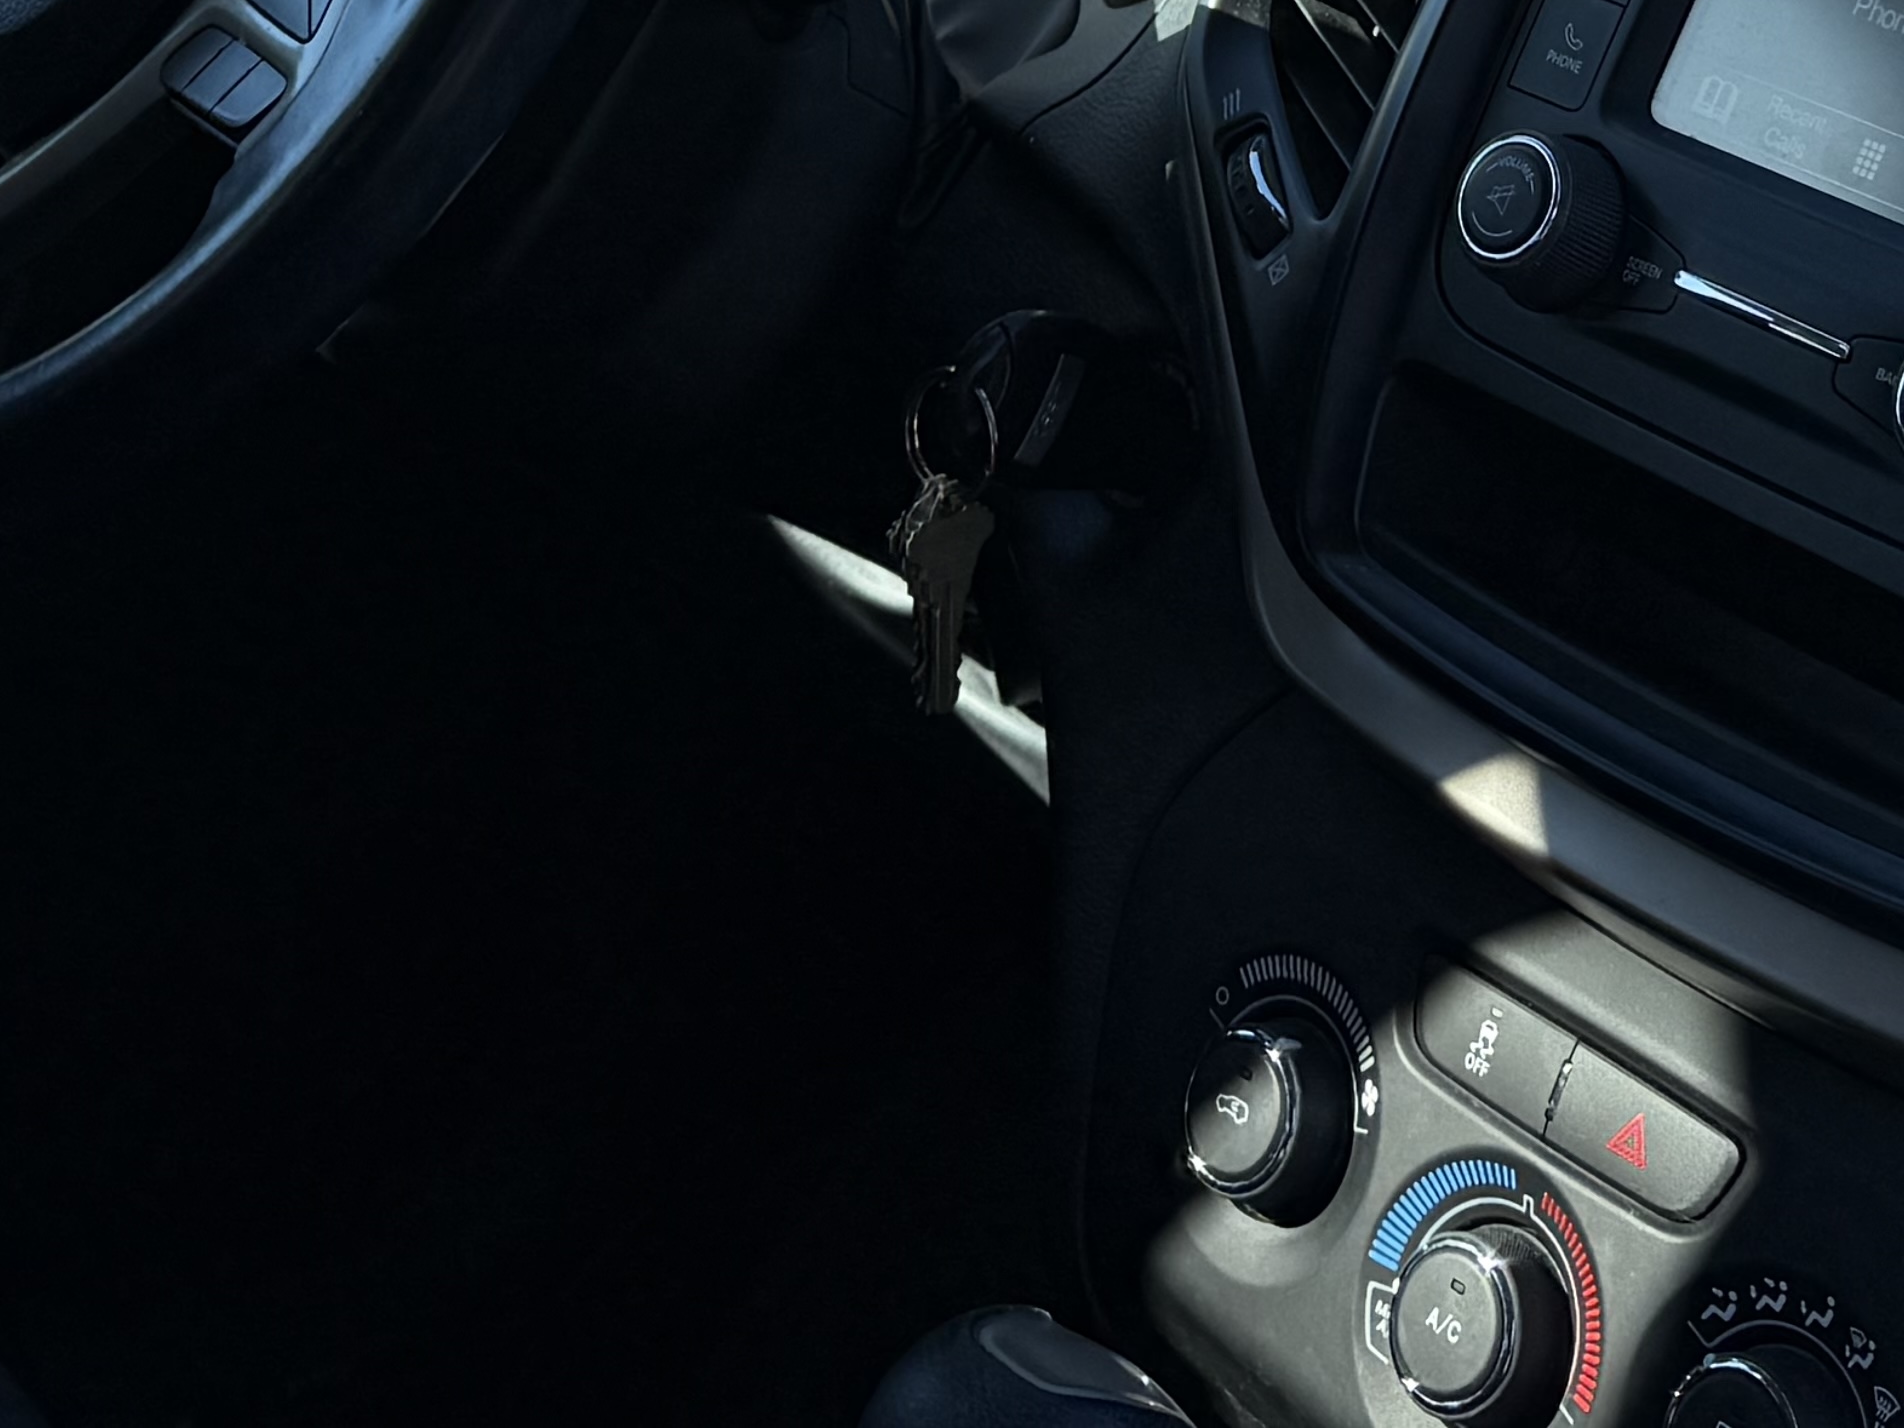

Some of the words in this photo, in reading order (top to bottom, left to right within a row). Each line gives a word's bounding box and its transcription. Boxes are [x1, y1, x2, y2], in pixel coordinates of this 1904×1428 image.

[1545, 49, 1584, 75] PHONE
[1767, 94, 1827, 135] Recent
[1764, 127, 1807, 159] Calls
[1497, 155, 1535, 183] VOLUME
[1621, 268, 1641, 287] OFF
[1626, 254, 1664, 280] SCREEN
[1464, 1051, 1491, 1078] OFF
[1425, 1306, 1462, 1345] A/C
